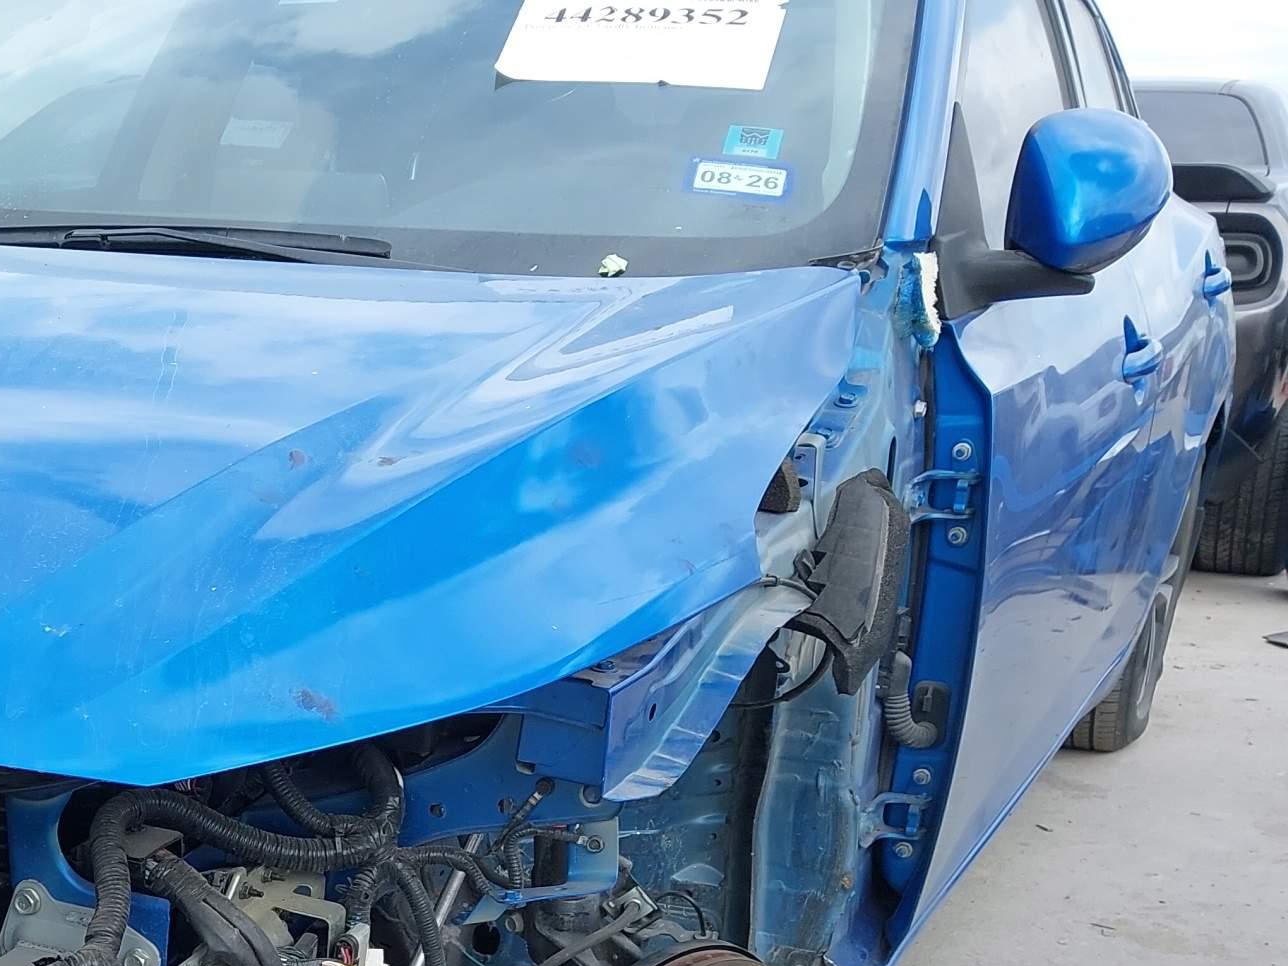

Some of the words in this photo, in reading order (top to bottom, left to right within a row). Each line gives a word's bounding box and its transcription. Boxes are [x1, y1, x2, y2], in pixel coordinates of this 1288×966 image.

[544, 6, 749, 25] 44289352
[700, 170, 732, 185] 08
[745, 174, 779, 190] 26
